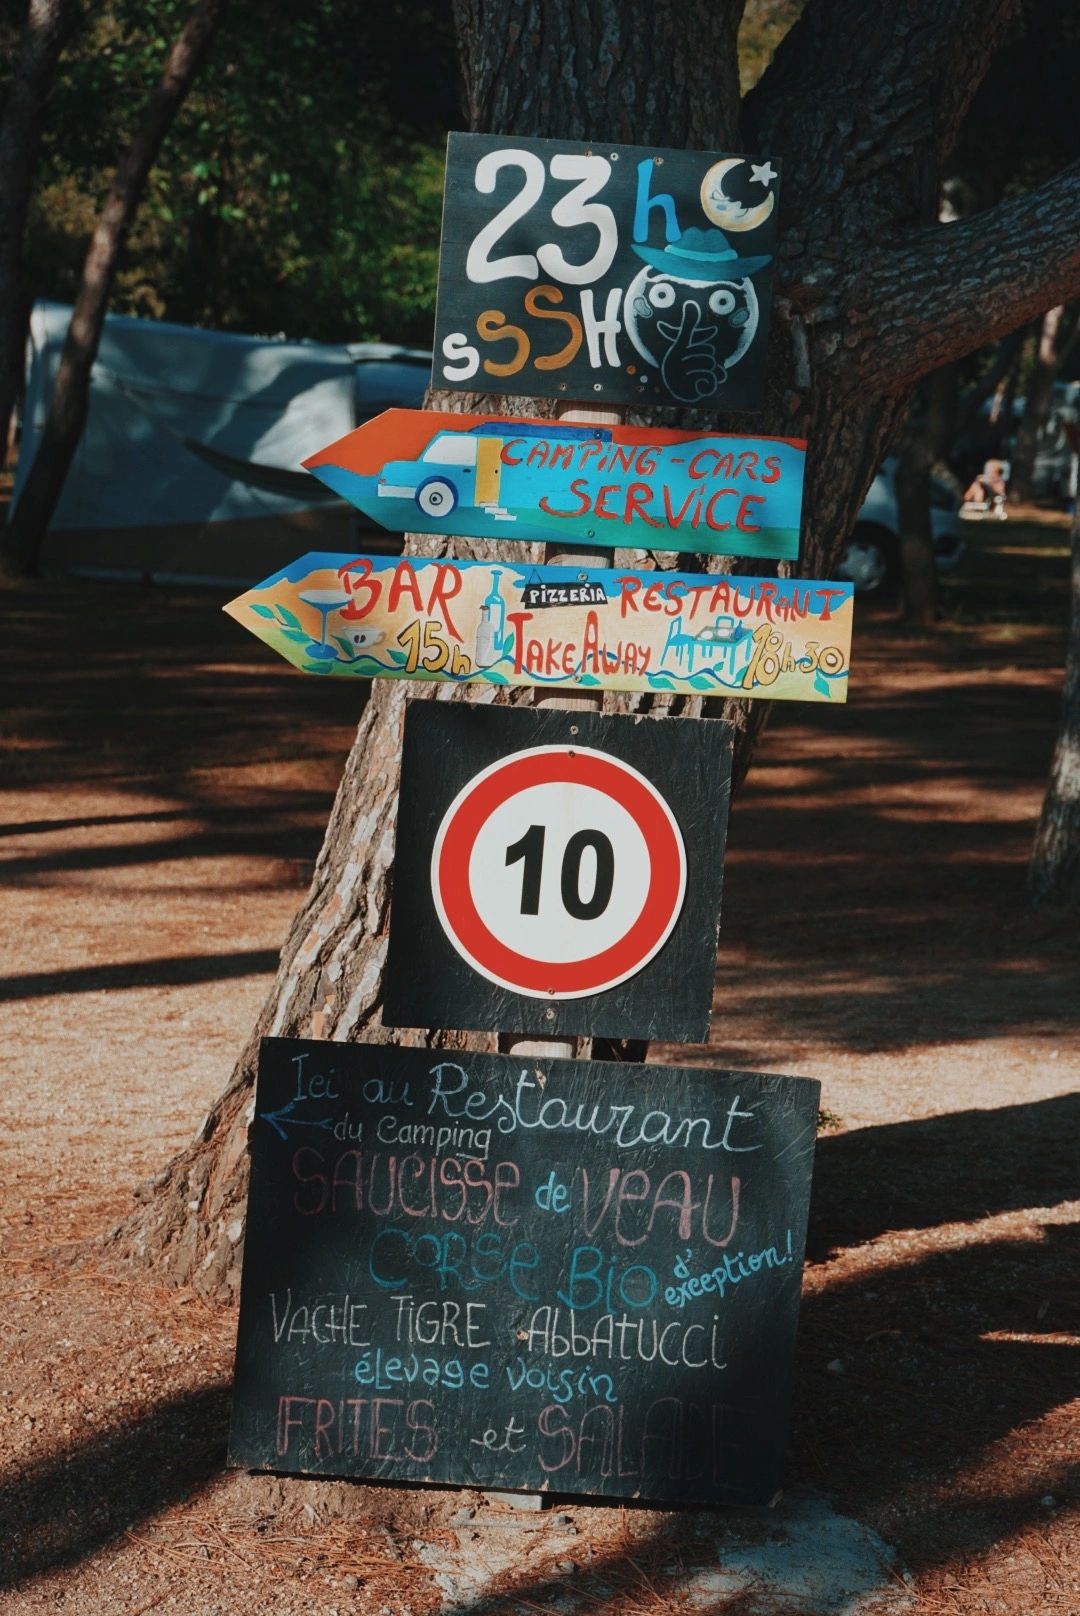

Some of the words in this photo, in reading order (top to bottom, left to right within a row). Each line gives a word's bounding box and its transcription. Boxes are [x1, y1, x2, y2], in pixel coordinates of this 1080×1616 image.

[338, 558, 464, 643] BAR
[397, 618, 471, 675] 15h
[742, 623, 844, 690] 18h30
[505, 825, 615, 921] 10
[291, 1053, 339, 1102] Ici
[363, 1078, 414, 1106] au
[427, 1062, 764, 1152] Restaurant
[333, 1112, 362, 1142] du
[377, 1115, 492, 1160] Camping
[535, 1171, 570, 1213] de
[673, 1248, 693, 1279] d'
[269, 1288, 370, 1347] VACHE
[276, 1396, 439, 1463] FRITES
[470, 1416, 527, 1453] et
